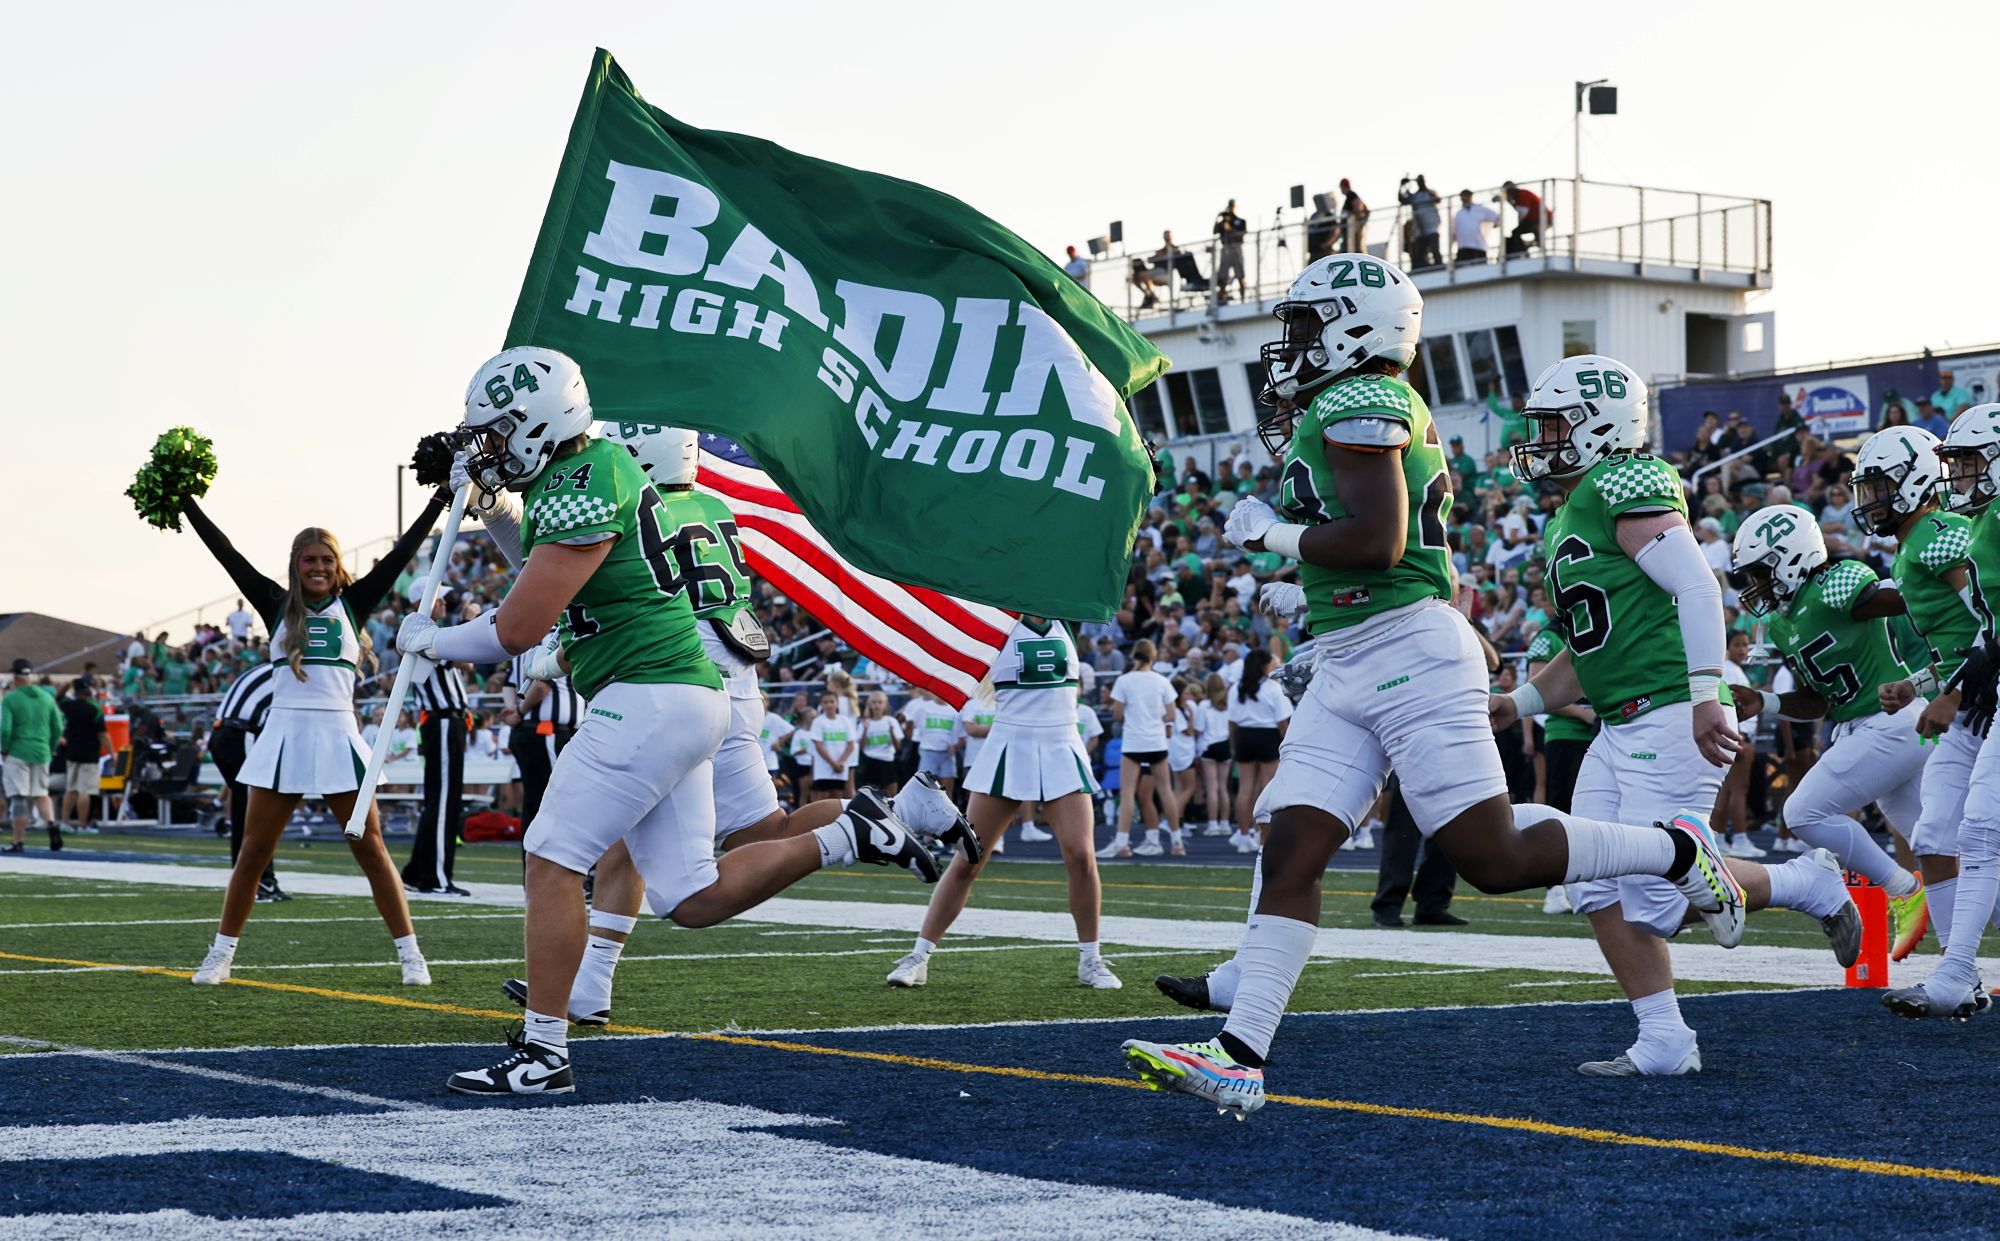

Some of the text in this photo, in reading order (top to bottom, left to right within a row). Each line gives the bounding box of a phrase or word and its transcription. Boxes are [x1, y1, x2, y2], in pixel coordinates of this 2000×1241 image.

[1329, 260, 1386, 289] 28
[582, 159, 1122, 437] BADIN
[485, 363, 539, 409] 64
[564, 265, 1106, 501] HIGH SCHOOL
[1576, 370, 1627, 400] 56
[543, 462, 594, 493] 64
[1755, 513, 1796, 548] 25
[1929, 518, 1950, 538] 1
[301, 615, 343, 661] B
[1014, 637, 1070, 685] B
[1636, 697, 1648, 706] XL
